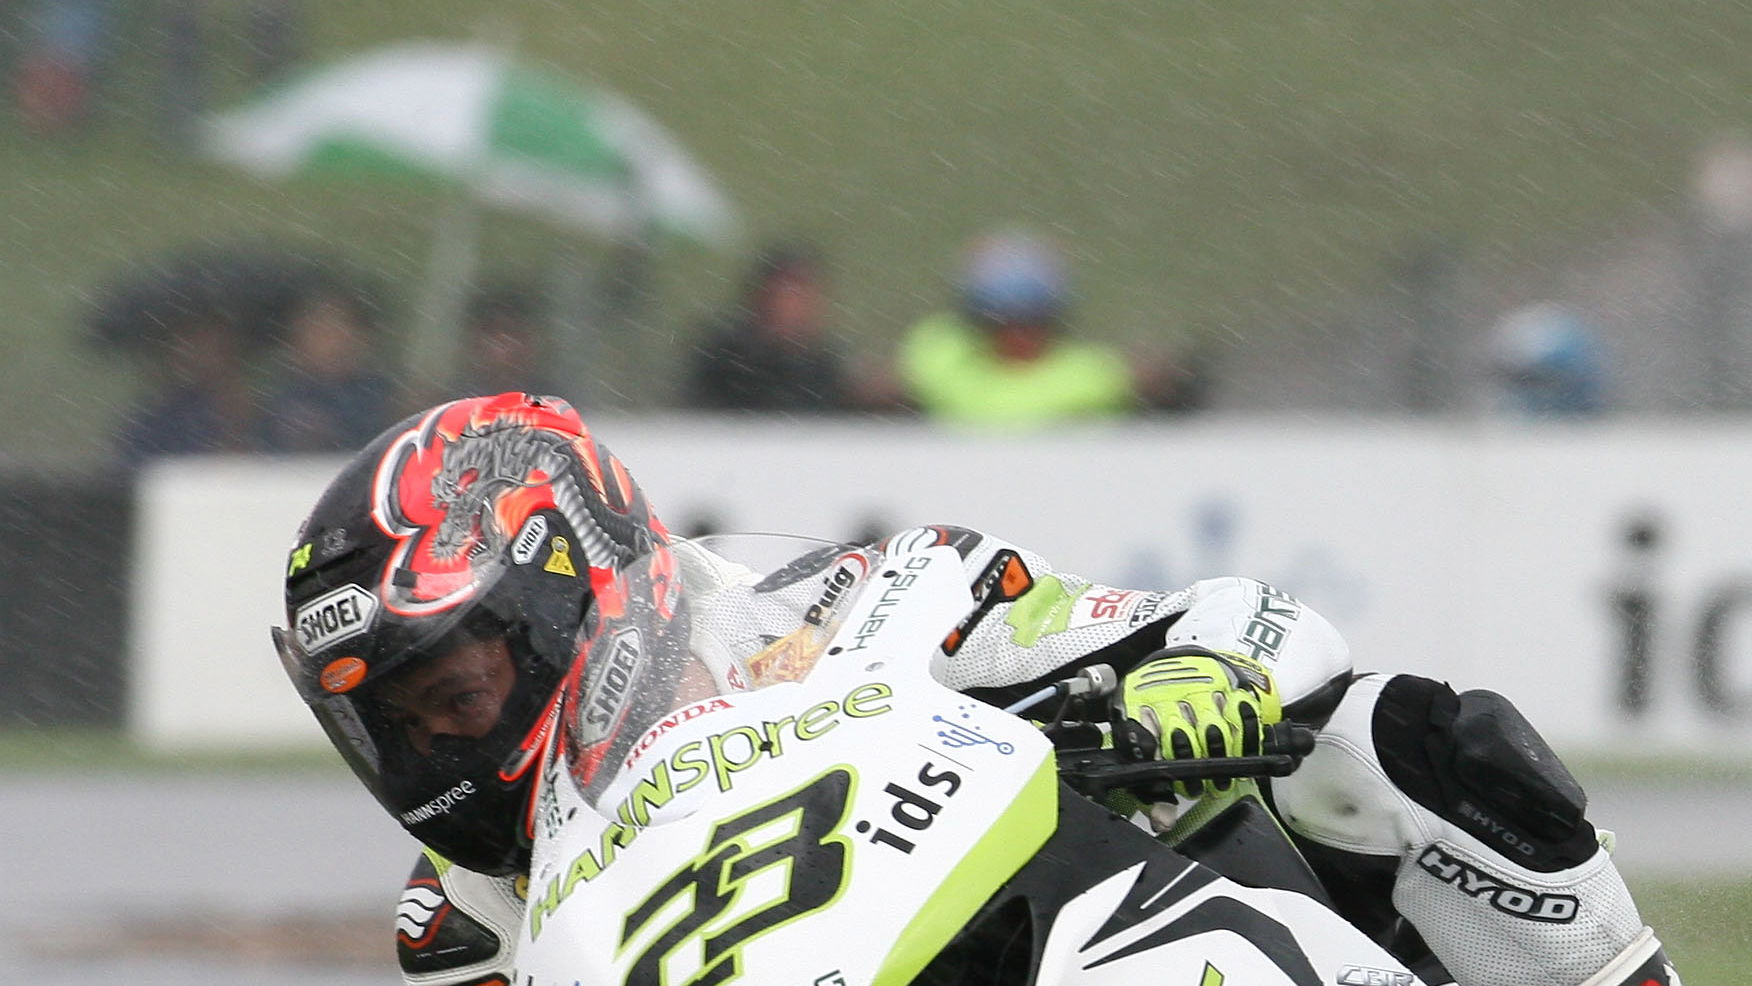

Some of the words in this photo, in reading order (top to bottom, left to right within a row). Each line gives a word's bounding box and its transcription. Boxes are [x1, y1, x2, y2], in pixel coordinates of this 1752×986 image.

[517, 519, 544, 559] SHOEI
[301, 594, 362, 646] SHOEI
[803, 565, 857, 627] Puig
[586, 640, 640, 733] SHOEI
[626, 698, 736, 769] HONDA
[854, 760, 963, 856] ids
[1420, 848, 1576, 921] HYOD
